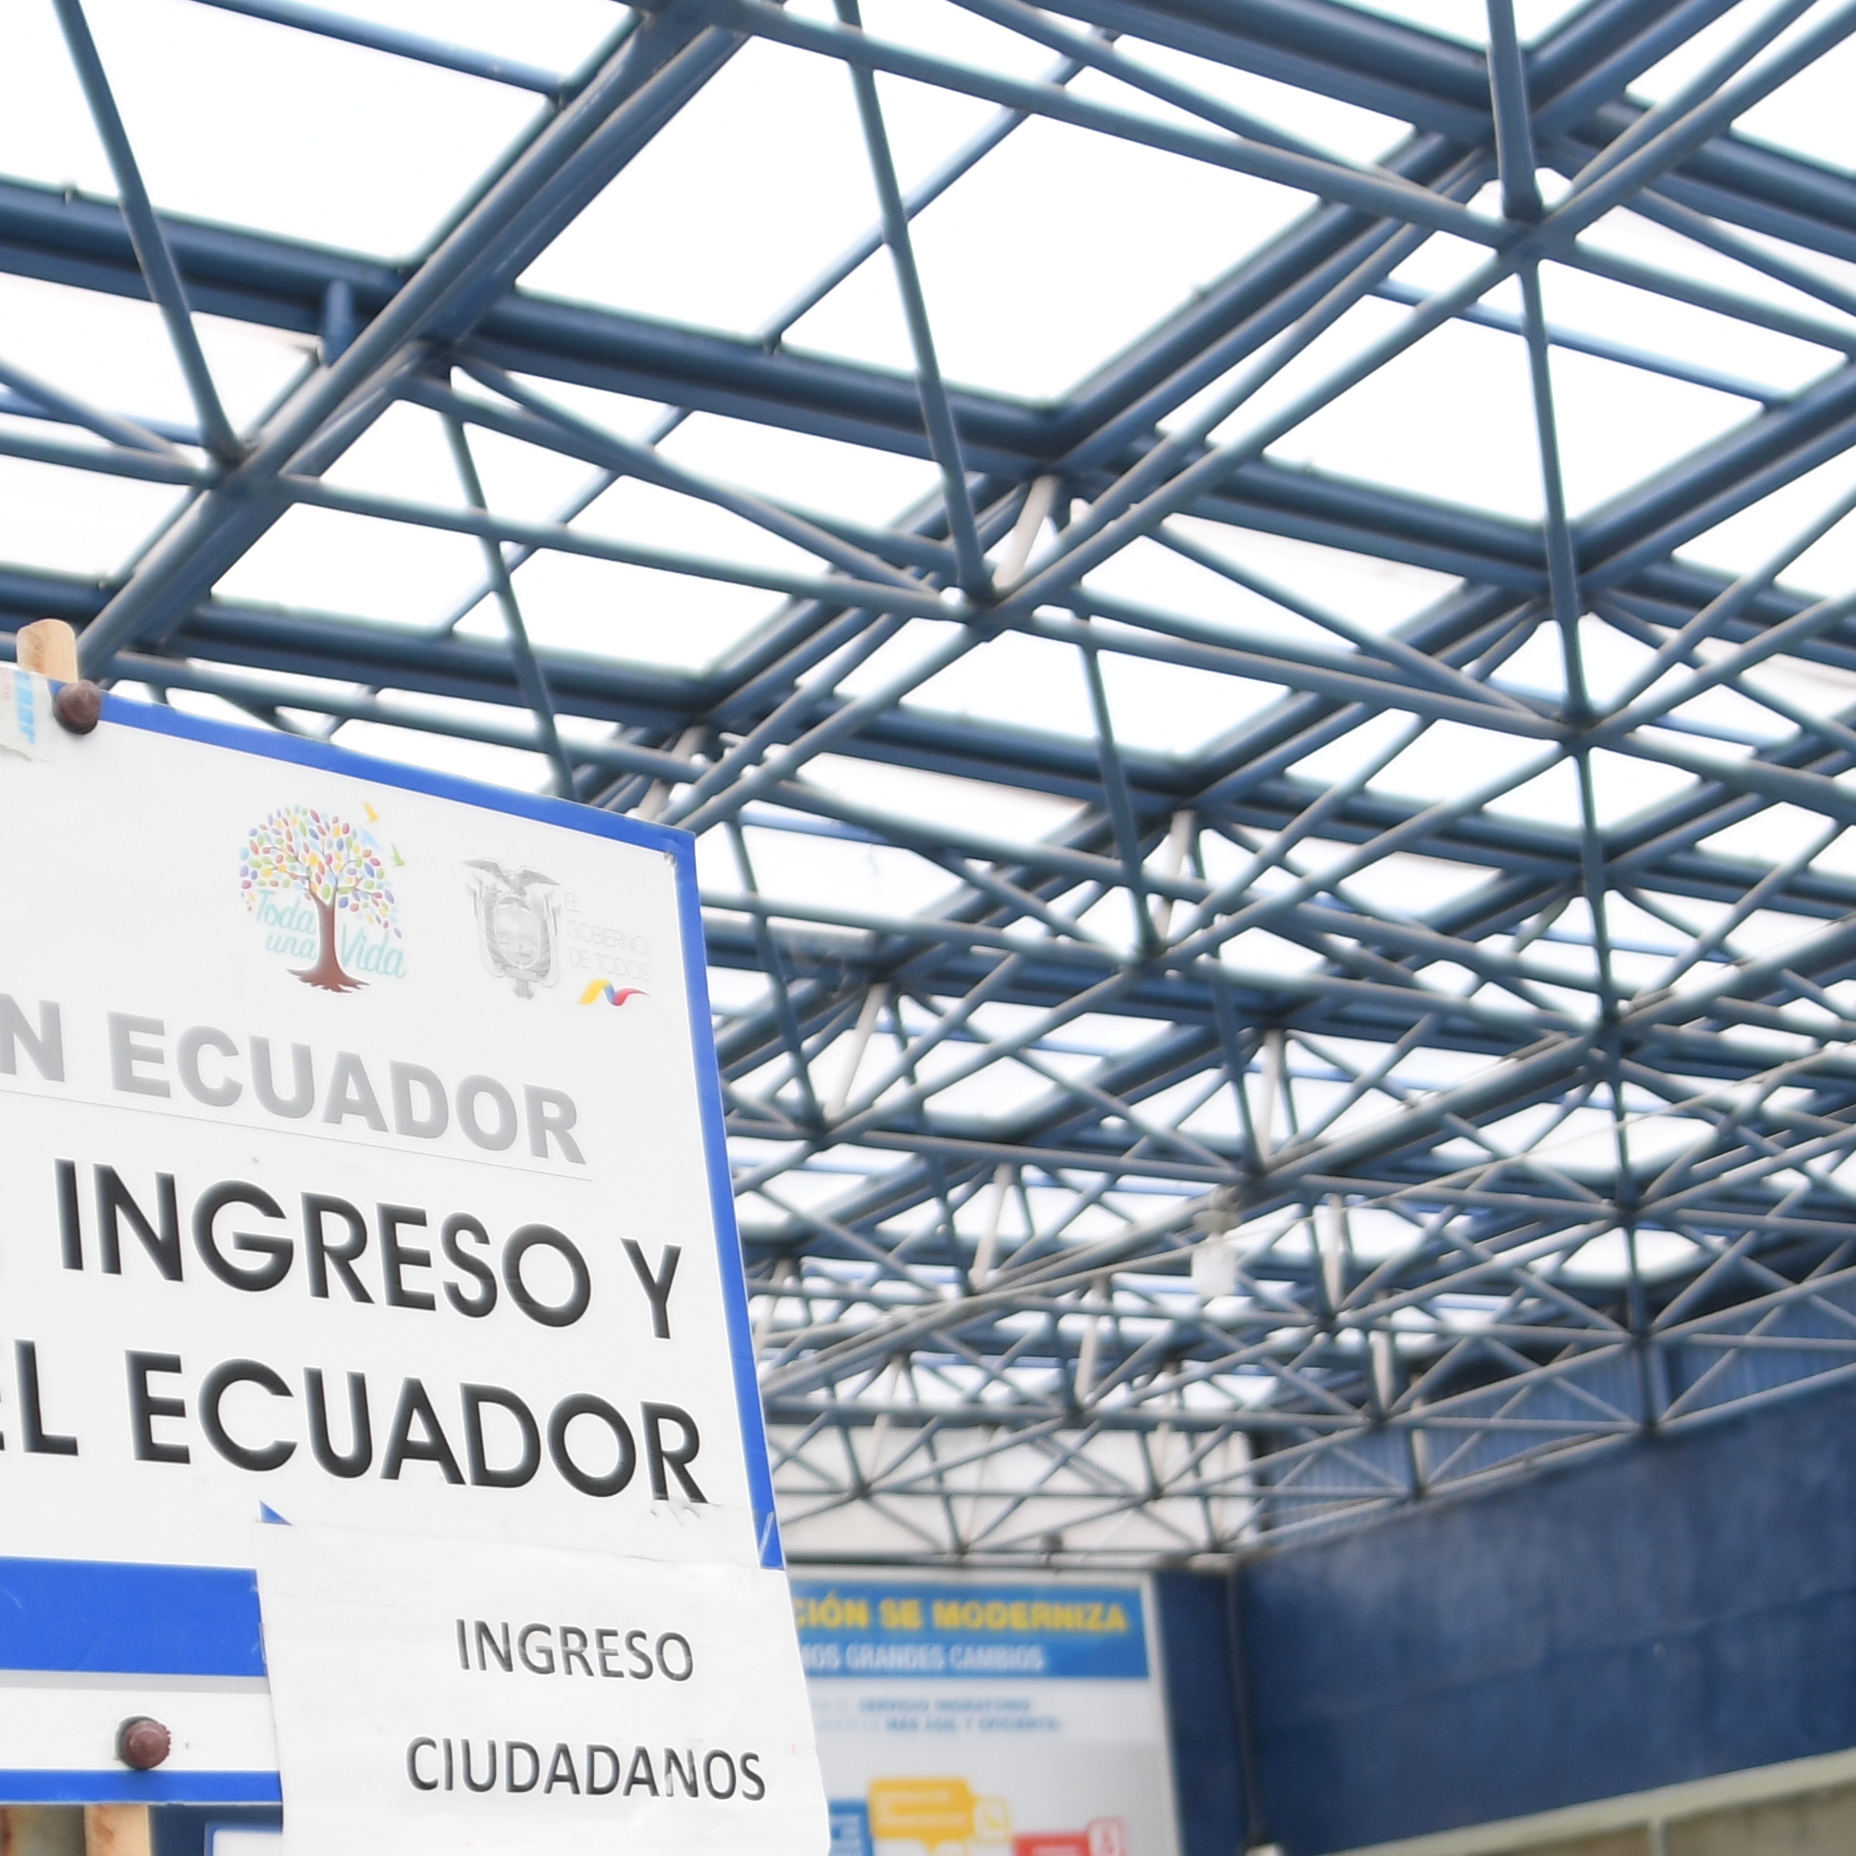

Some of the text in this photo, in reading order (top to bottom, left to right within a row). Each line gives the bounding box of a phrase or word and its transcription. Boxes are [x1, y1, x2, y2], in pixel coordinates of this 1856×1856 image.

[256, 888, 318, 935] Toda
[566, 919, 648, 955] GOBIERNO
[265, 933, 318, 961] una
[340, 922, 407, 979] Vida
[568, 946, 651, 982] DE TODOS
[106, 1010, 588, 1167] ECUADOR
[56, 1159, 593, 1329] INGRESO
[623, 1239, 683, 1341] Y
[126, 1350, 711, 1505] ECUADOR
[879, 1598, 921, 1629] SE
[932, 1600, 1128, 1631] MODERNIZA
[455, 1619, 695, 1682] INGRESO
[845, 1643, 945, 1669] GRANDES
[949, 1644, 1044, 1670] CAMBIOS
[406, 1736, 767, 1801] CIUDADANOS
